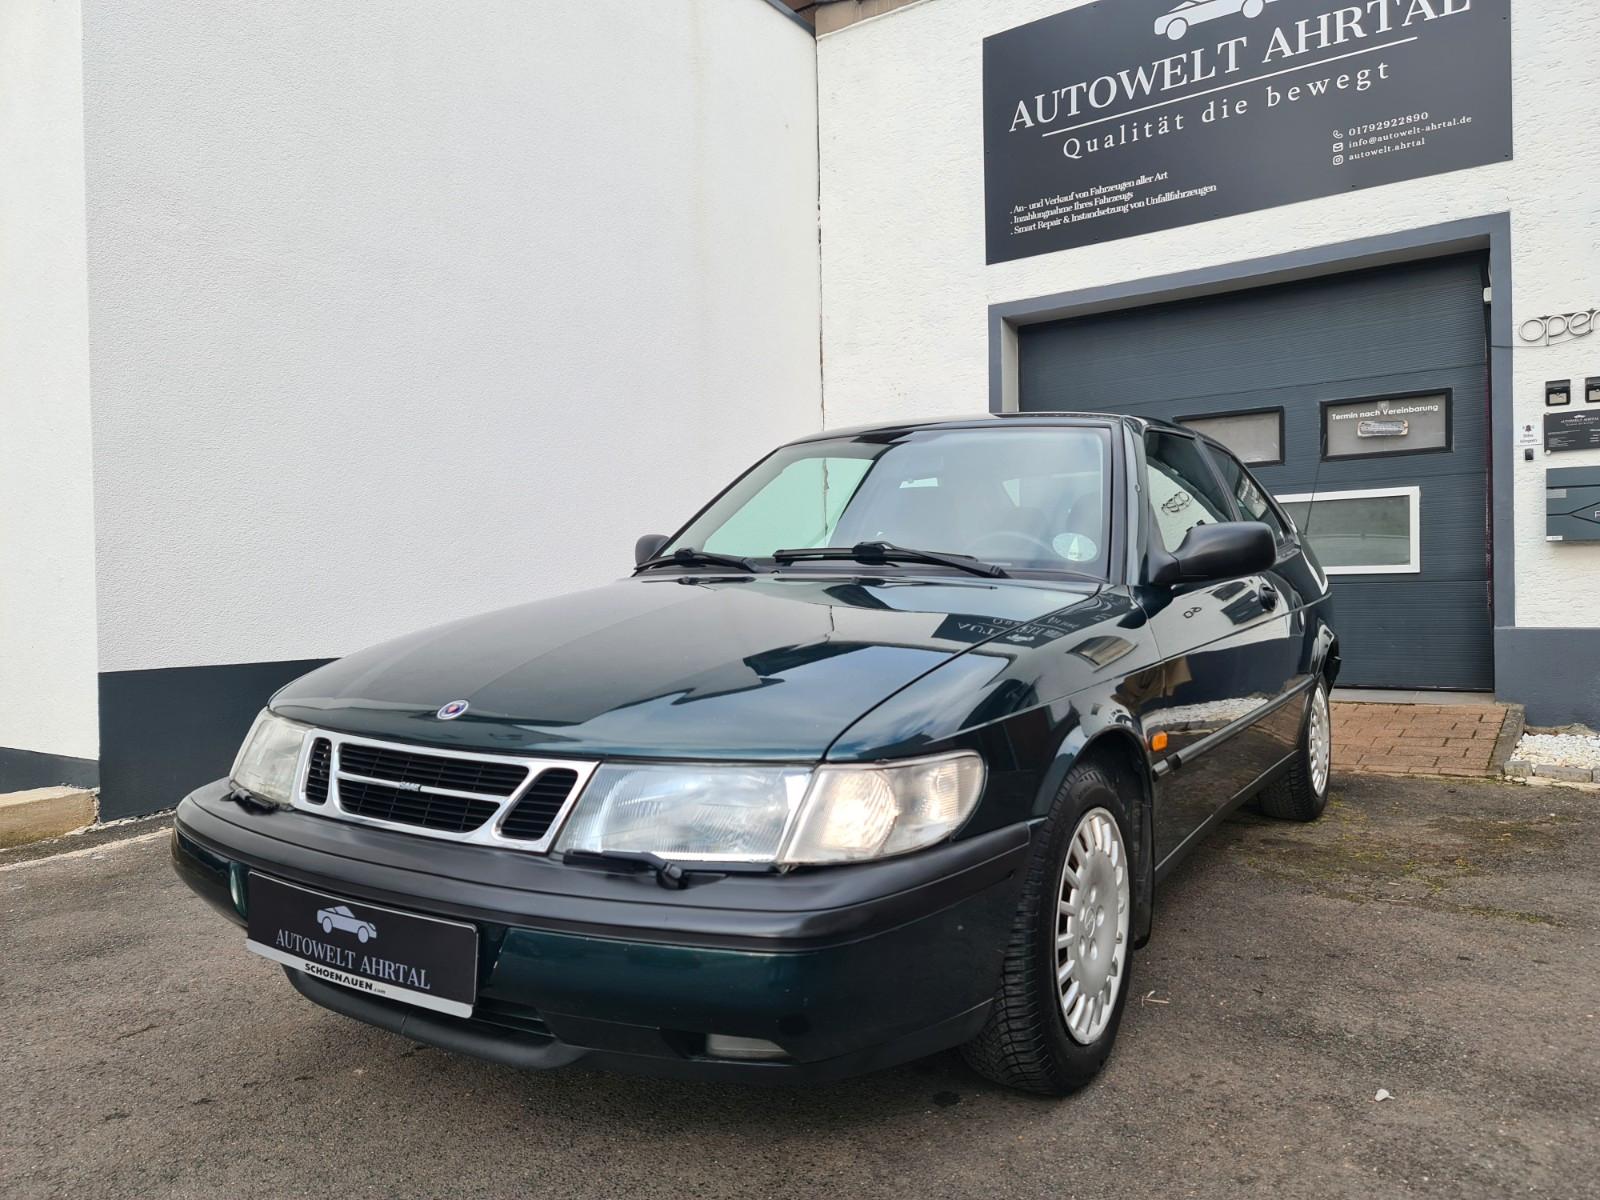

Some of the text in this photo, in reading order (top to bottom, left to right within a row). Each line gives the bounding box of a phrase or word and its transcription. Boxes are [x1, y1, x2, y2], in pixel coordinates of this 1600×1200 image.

[1009, 36, 1248, 132] AUTOWELT
[1063, 62, 1390, 159] Qualität die bewegt
[1348, 111, 1429, 136] 01792922890
[1348, 115, 1473, 149] info@autowelt-ahrtal.de
[1348, 137, 1426, 161] autowelt.ahrtal
[1013, 171, 1169, 214] An- und Verkauf von Fahrzeugen aller Art
[1013, 184, 1217, 235] Smart Repair & Instandsetzung von Unfallfahrzeugen
[1074, 200, 1094, 211] Ihres
[1094, 190, 1134, 206] Fahrzeugs
[1331, 404, 1439, 421] Termin nach Vereinbarung
[275, 928, 431, 990] AUTOWELT AHRTAL
